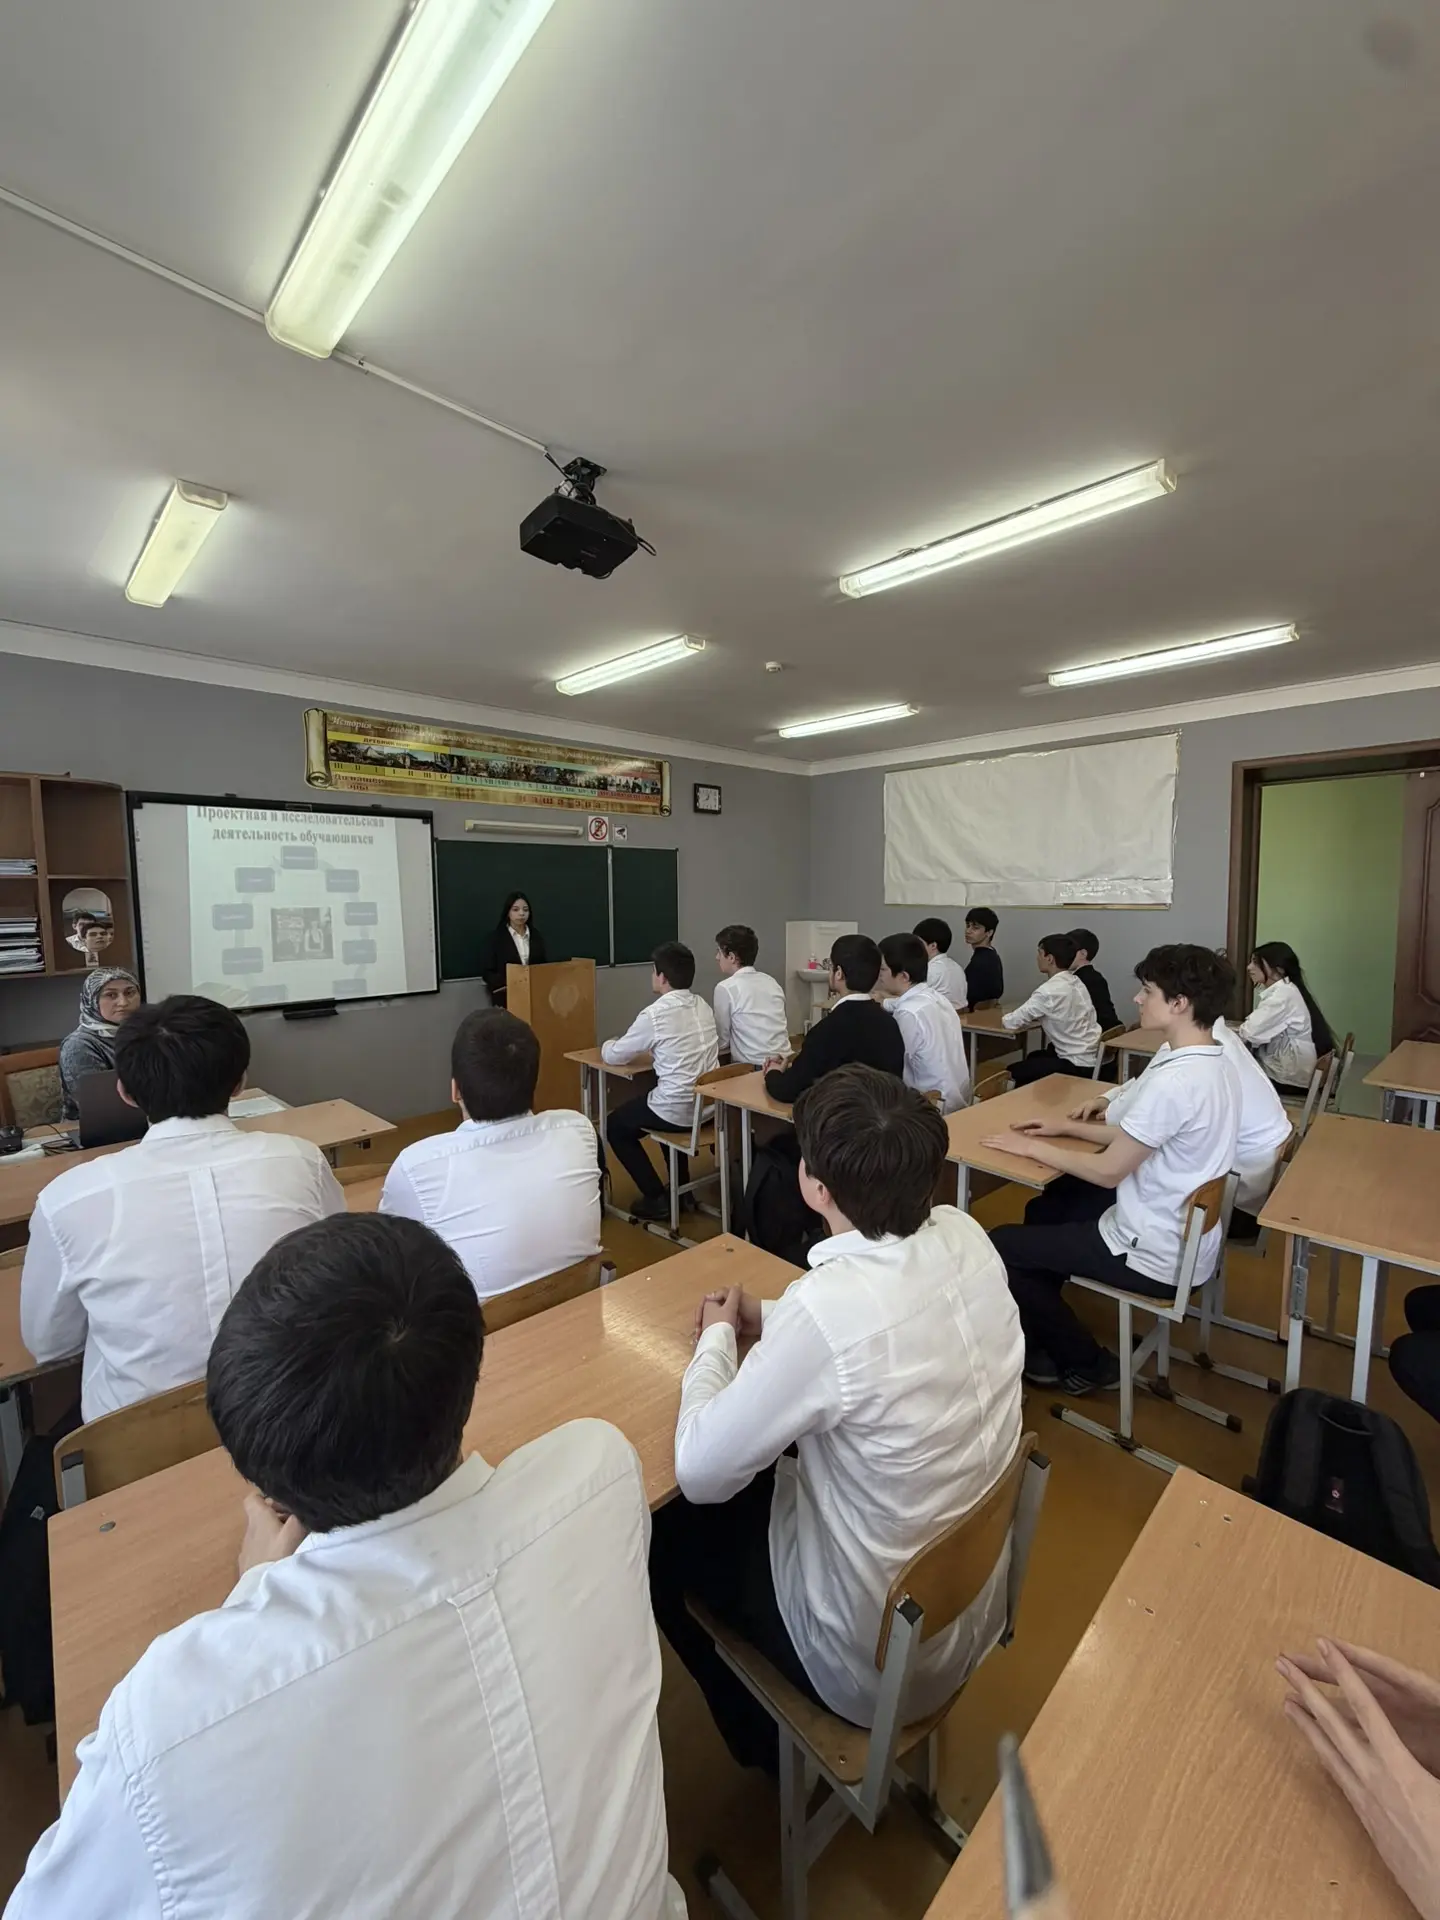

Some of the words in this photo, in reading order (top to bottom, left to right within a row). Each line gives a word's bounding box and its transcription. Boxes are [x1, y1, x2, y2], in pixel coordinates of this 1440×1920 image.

[331, 716, 372, 731] История
[197, 806, 267, 823] Проектная
[271, 812, 278, 822] и
[281, 812, 385, 828] исследовательская
[212, 828, 298, 842] деятельность
